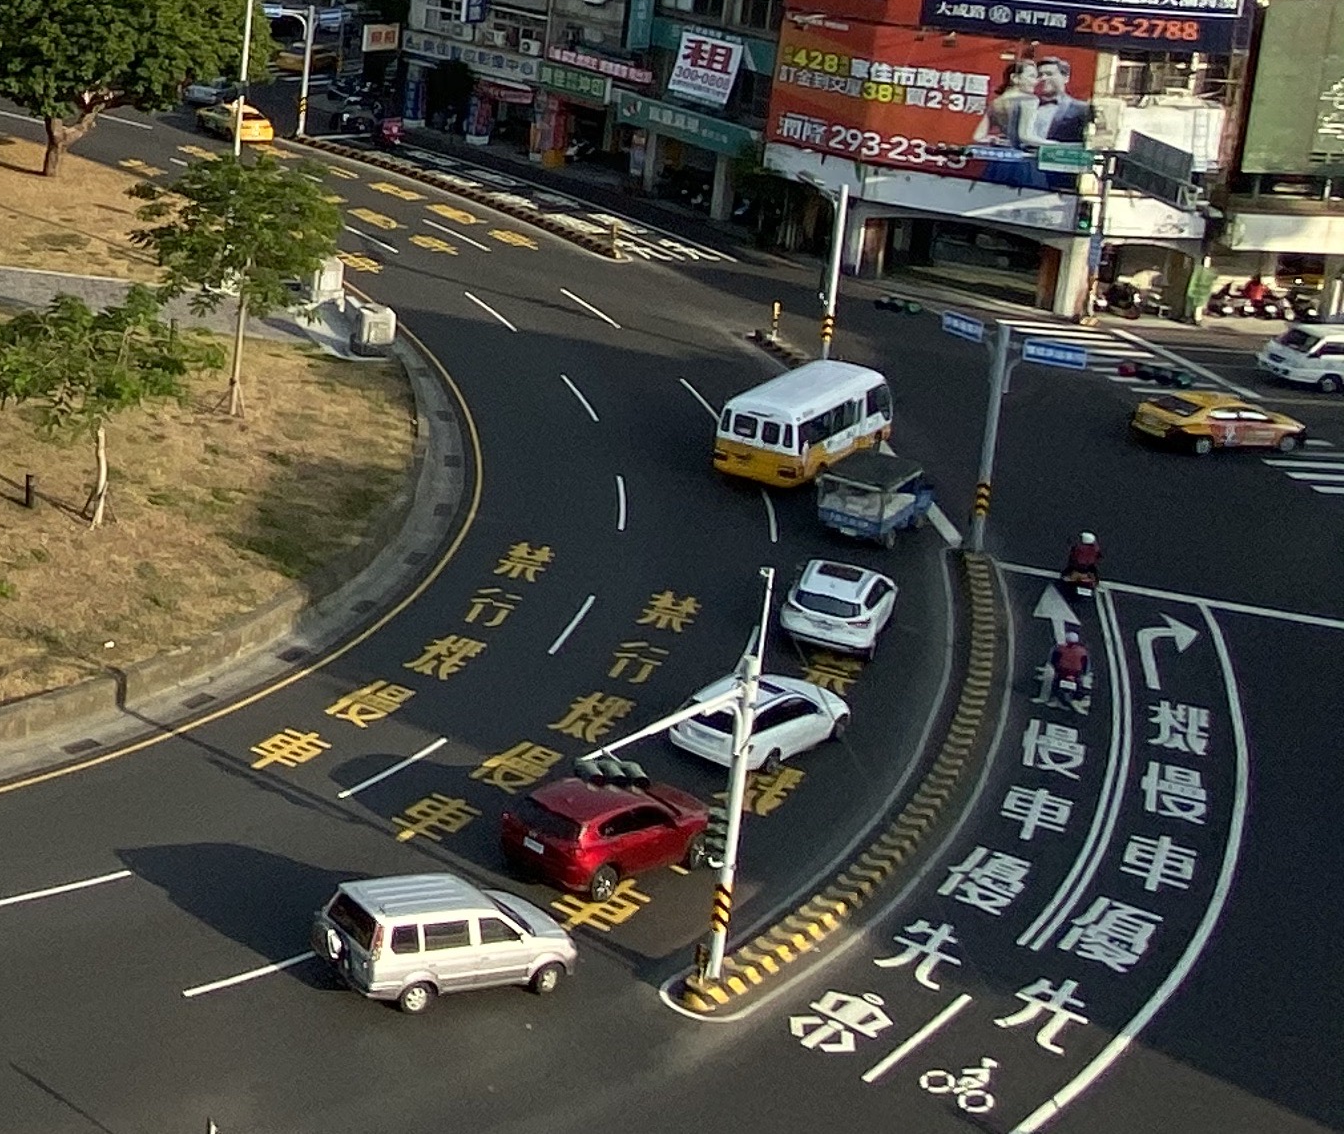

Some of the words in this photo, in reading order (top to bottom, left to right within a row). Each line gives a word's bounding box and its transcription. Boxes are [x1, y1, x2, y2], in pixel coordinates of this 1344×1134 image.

[682, 38, 732, 75] 租
[1075, 14, 1200, 42] 265-2788
[250, 541, 556, 770] 禁行機慢車
[391, 590, 703, 843] 禁行機慢車
[994, 700, 1212, 1056] 機慢車優先
